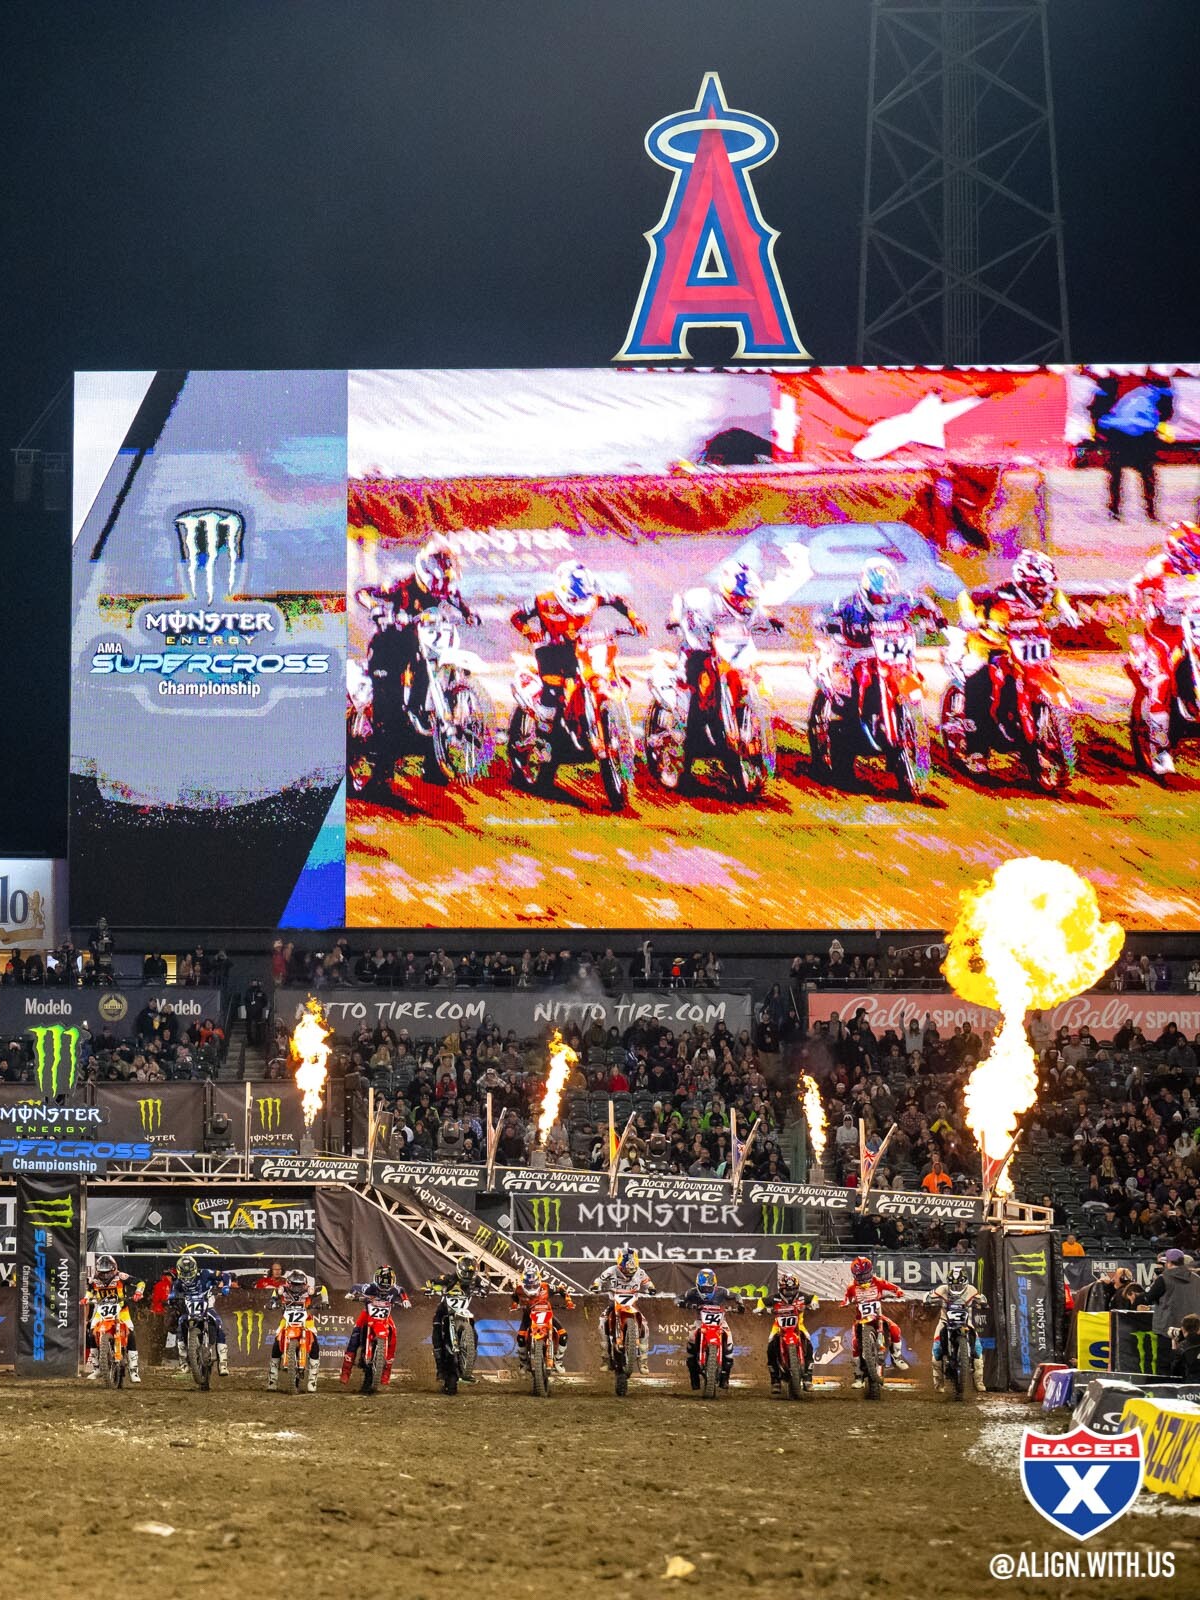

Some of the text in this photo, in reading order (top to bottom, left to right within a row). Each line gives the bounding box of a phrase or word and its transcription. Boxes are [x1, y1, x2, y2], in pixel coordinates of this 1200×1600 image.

[145, 609, 275, 635] MONSTER
[166, 635, 256, 646] ENERGY
[97, 642, 123, 654] AMA
[90, 653, 331, 674] SUPERCROSS
[158, 680, 261, 699] Championship
[25, 998, 73, 1016] Modelo
[374, 1001, 486, 1020] TIRE.COM
[533, 1002, 726, 1022] NITTO TIRE.COM
[841, 997, 932, 1031] Bally
[1051, 998, 1145, 1030] Bally
[0, 1104, 103, 1124] MONSTER
[15, 1125, 87, 1133] ENERGY
[12, 1157, 97, 1173] Championship
[276, 1158, 359, 1170] ROCKY MOUNTAIN
[397, 1164, 480, 1177] ROCKY MOUNTAIN
[519, 1170, 601, 1183] ROCKY MOUNTAIN
[641, 1178, 723, 1191] ROCKY MOUNTAIN
[765, 1183, 848, 1198] ROCKY MOUNTAIN
[892, 1195, 976, 1209] ROCKY MOUNTAIN
[577, 1199, 743, 1228] MONSTER
[21, 1265, 31, 1322] Championship
[33, 1228, 46, 1361] SUPERCROSS
[57, 1258, 70, 1329] MONSTER
[618, 1294, 634, 1304] 7
[187, 1302, 204, 1312] 14
[450, 1298, 466, 1309] 27
[861, 1302, 878, 1315] 51
[100, 1305, 118, 1317] 34
[287, 1311, 306, 1324] 12
[371, 1307, 389, 1319] 23
[535, 1311, 547, 1323] 1
[704, 1313, 721, 1325] 94
[780, 1316, 795, 1327] 10
[1035, 1298, 1046, 1351] MONSTER
